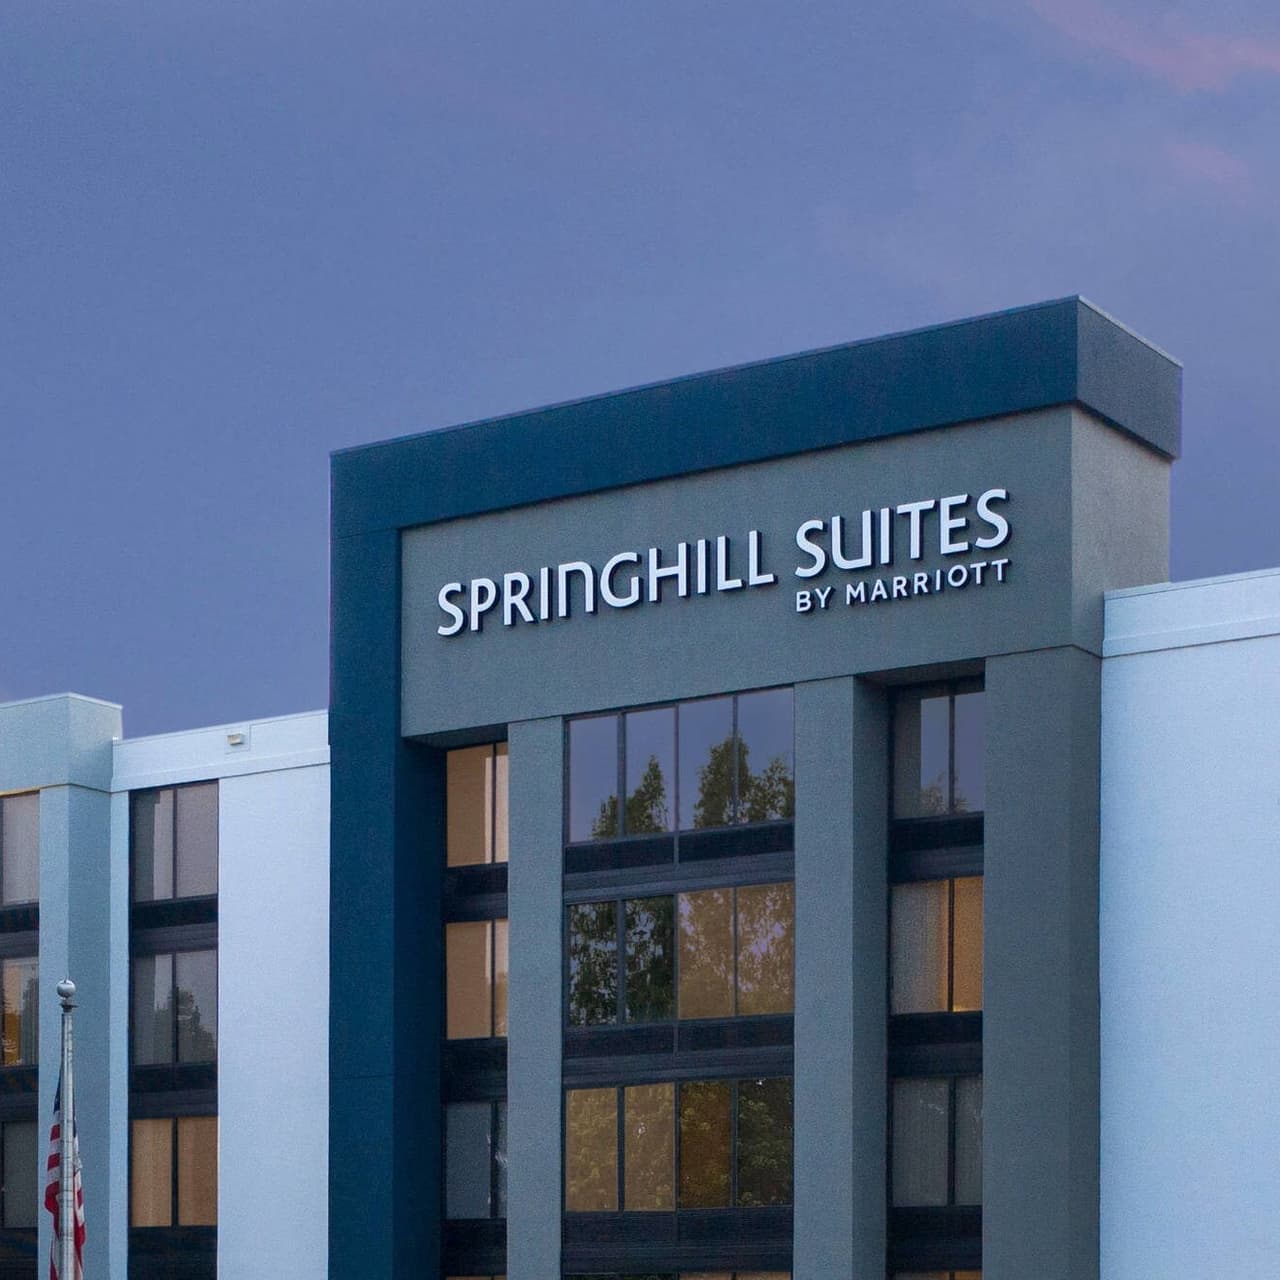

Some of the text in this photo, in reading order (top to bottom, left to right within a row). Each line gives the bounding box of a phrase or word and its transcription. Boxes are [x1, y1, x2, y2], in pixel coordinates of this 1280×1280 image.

[437, 489, 1009, 637] SPRINGHILL SUITES
[796, 558, 1009, 612] BY MARRIOTT
